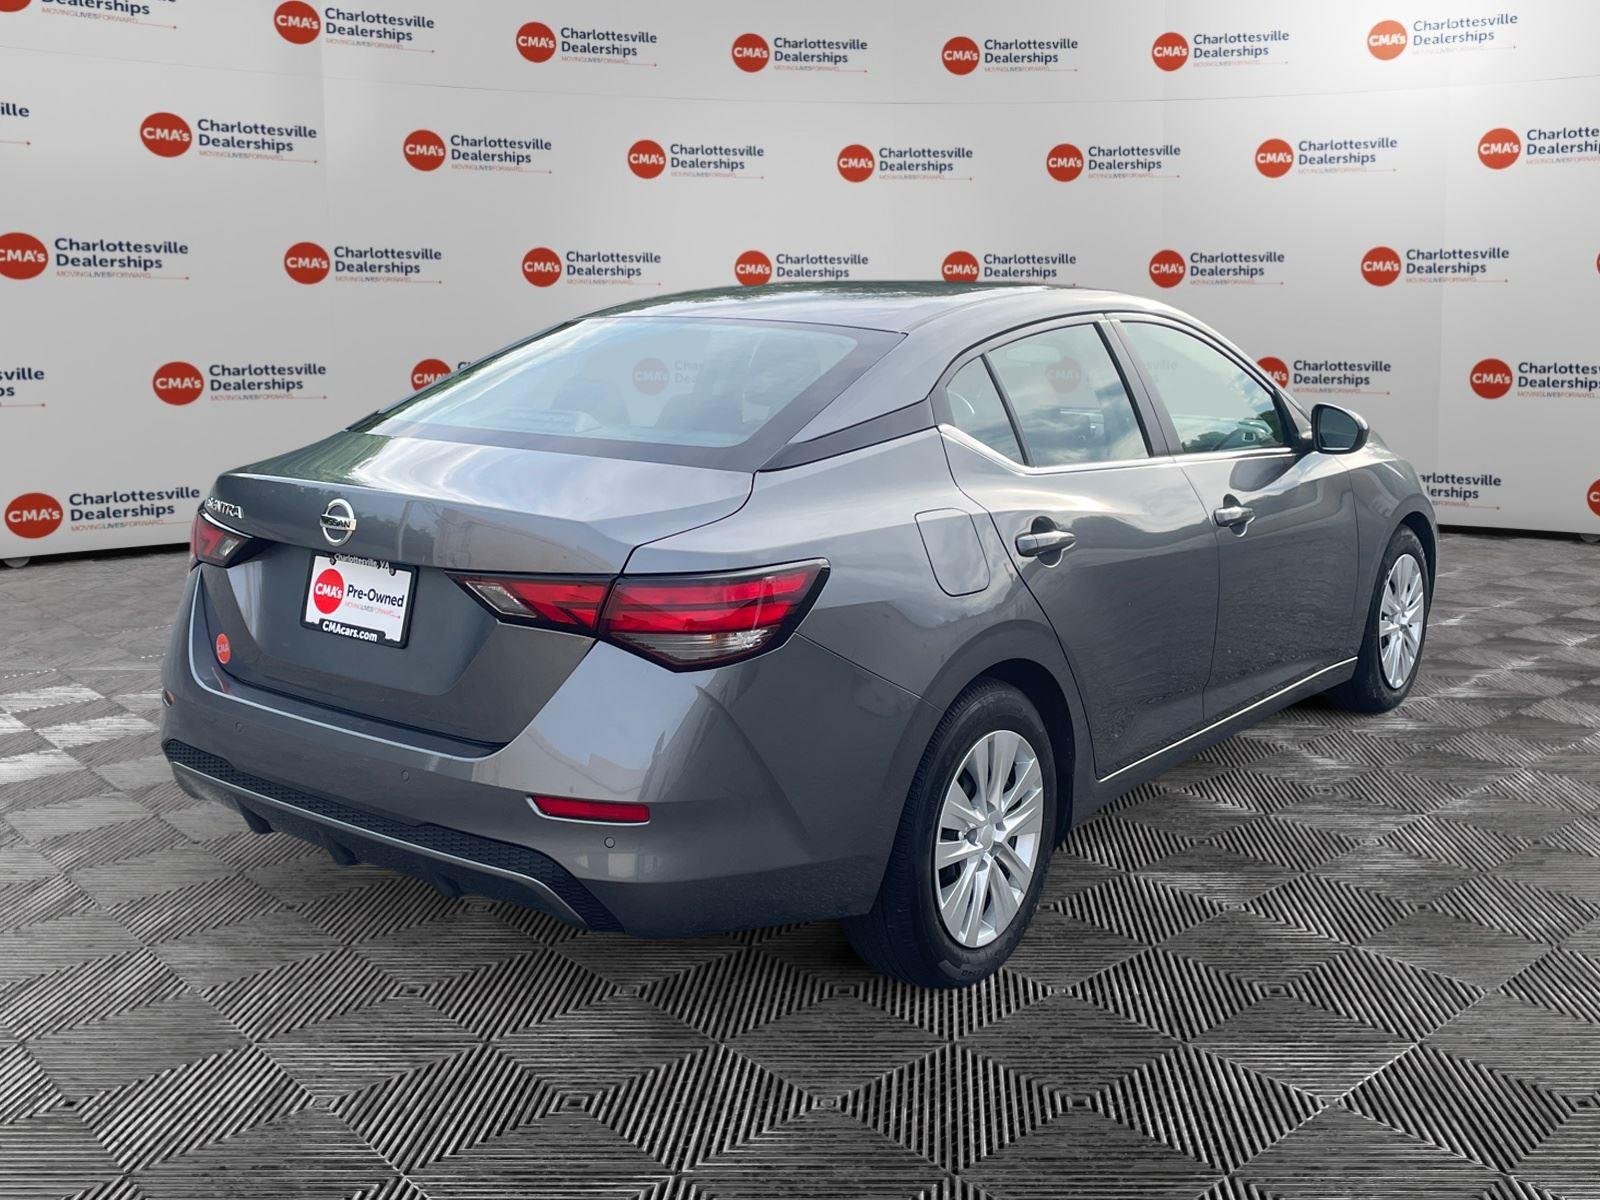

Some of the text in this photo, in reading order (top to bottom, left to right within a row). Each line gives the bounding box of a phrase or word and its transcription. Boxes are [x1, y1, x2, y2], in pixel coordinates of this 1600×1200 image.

[42, 0, 150, 16] alerships
[276, 15, 318, 29] CMA's
[325, 8, 434, 29] Charlottesville
[1413, 13, 1518, 31] Charlottesville
[326, 22, 413, 43] Dealerships
[561, 27, 657, 43] Charlottesville
[1193, 31, 1289, 45] Charlottesville
[1414, 32, 1494, 46] Dealerships
[519, 36, 554, 48] CMA's
[774, 37, 868, 50] Charlottesville
[984, 38, 1078, 50] Charlottesville
[1369, 33, 1406, 46] CMA's
[561, 41, 637, 58] Dealerships
[735, 47, 768, 58] CMA's
[945, 51, 977, 60] CMA's
[1153, 46, 1187, 57] CMA's
[1193, 45, 1269, 59] Dealerships
[774, 51, 848, 65] Dealerships
[985, 52, 1058, 65] Dealerships
[143, 128, 190, 141] CMA's
[197, 119, 317, 138] Charlottesville
[199, 134, 293, 154] Dealerships
[450, 135, 552, 150] Charlottesville
[1299, 138, 1397, 151] Charlottesville
[1480, 143, 1519, 154] CMA's
[1527, 140, 1600, 155] Dealershi
[406, 144, 444, 156] CMA's
[670, 144, 764, 156] Charlottesville
[879, 147, 973, 158] Charlottesville
[1088, 145, 1180, 157] Charlottesville
[451, 149, 531, 165] Dealerships
[630, 154, 663, 164] CMA's
[841, 158, 872, 168] CMA's
[1049, 158, 1082, 167] CMA's
[1258, 153, 1292, 163] CMA's
[1299, 152, 1376, 165] Dealerships
[671, 157, 745, 172] Dealerships
[880, 161, 953, 174] Dealerships
[1088, 158, 1162, 172] Dealerships
[55, 238, 188, 254] Charlottesville
[334, 246, 441, 260] Charlottesville
[566, 251, 661, 263] Charlottesville
[776, 254, 868, 265] Charlottesville
[984, 253, 1076, 264] Charlottesville
[1190, 252, 1284, 263] Charlottesville
[1406, 247, 1509, 260] Charlottesville
[56, 253, 162, 272] Dealerships
[287, 257, 328, 268] CMA's
[335, 260, 420, 276] Dealerships
[525, 262, 559, 272] CMA's
[738, 264, 770, 274] CMA's
[1152, 264, 1184, 273] CMA's
[1364, 261, 1399, 271] CMA's
[1406, 262, 1486, 276] Dealerships
[567, 264, 641, 279] Dealerships
[777, 266, 850, 278] Dealerships
[945, 265, 977, 274] CMA's
[984, 266, 1057, 280] Dealerships
[1190, 265, 1264, 278] Dealerships
[209, 363, 326, 376] Charlottesville
[1293, 360, 1391, 372] Charlottesville
[157, 377, 201, 389] CMA's
[1293, 373, 1370, 388] Dealerships
[1473, 373, 1511, 384] CMA's
[210, 378, 303, 393] Dealerships
[1420, 472, 1501, 486] arlottesville
[69, 487, 200, 506] Charlottesville
[1427, 486, 1479, 500] lerships
[8, 508, 61, 523] CMA's
[70, 504, 175, 521] Dealerships
[315, 582, 343, 599] CMA's
[347, 584, 404, 607] Pre-Owned
[322, 621, 378, 642] CMAcars.com
